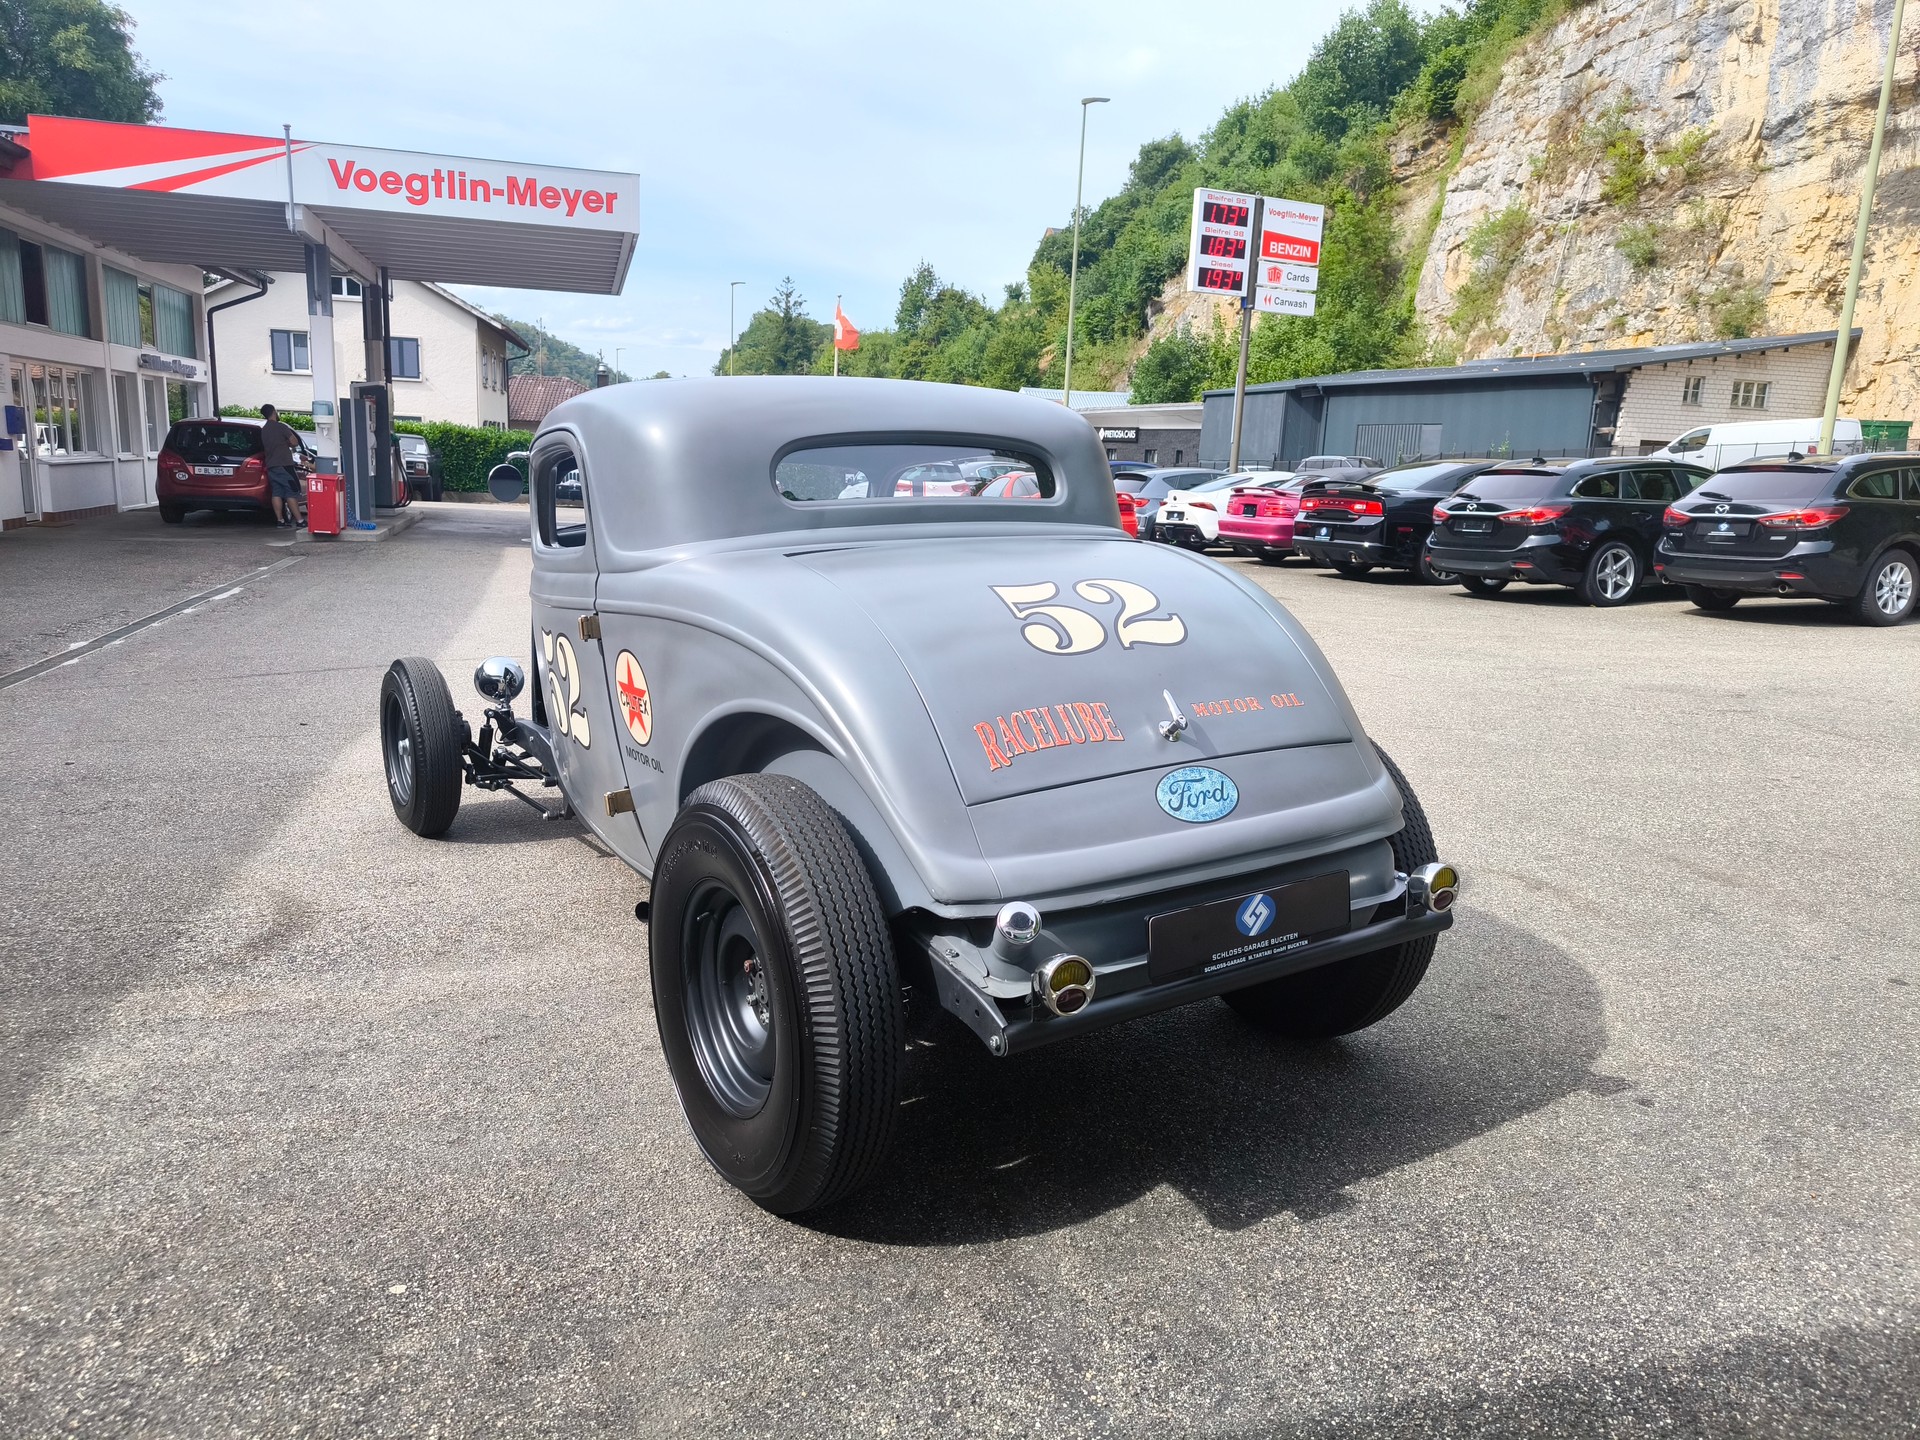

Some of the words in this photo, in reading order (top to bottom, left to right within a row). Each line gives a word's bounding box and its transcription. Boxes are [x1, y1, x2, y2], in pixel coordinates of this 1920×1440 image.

[327, 158, 618, 217] Voegtlin-Meyer
[1207, 193, 1234, 204] Bleifrei
[1236, 197, 1247, 205] 95
[1268, 207, 1320, 223] Voegtlin-Meyer
[1204, 226, 1231, 236] Bleifrei
[1269, 241, 1312, 258] BENZIN
[1210, 260, 1234, 269] Diesel
[1286, 271, 1310, 283] Cards
[1273, 297, 1308, 309] Carwash
[988, 578, 1188, 656] 52
[620, 690, 649, 716] CALTEX
[973, 701, 1125, 771] RACELUBE
[1190, 696, 1265, 718] MOTOR
[1270, 693, 1305, 709] OIL
[626, 745, 650, 768] MOTOR
[651, 758, 664, 774] OIL
[1168, 776, 1231, 812] Ford
[1212, 939, 1270, 961] SCHLOSS-GARAGE
[1270, 932, 1299, 946] BUCKTEN
